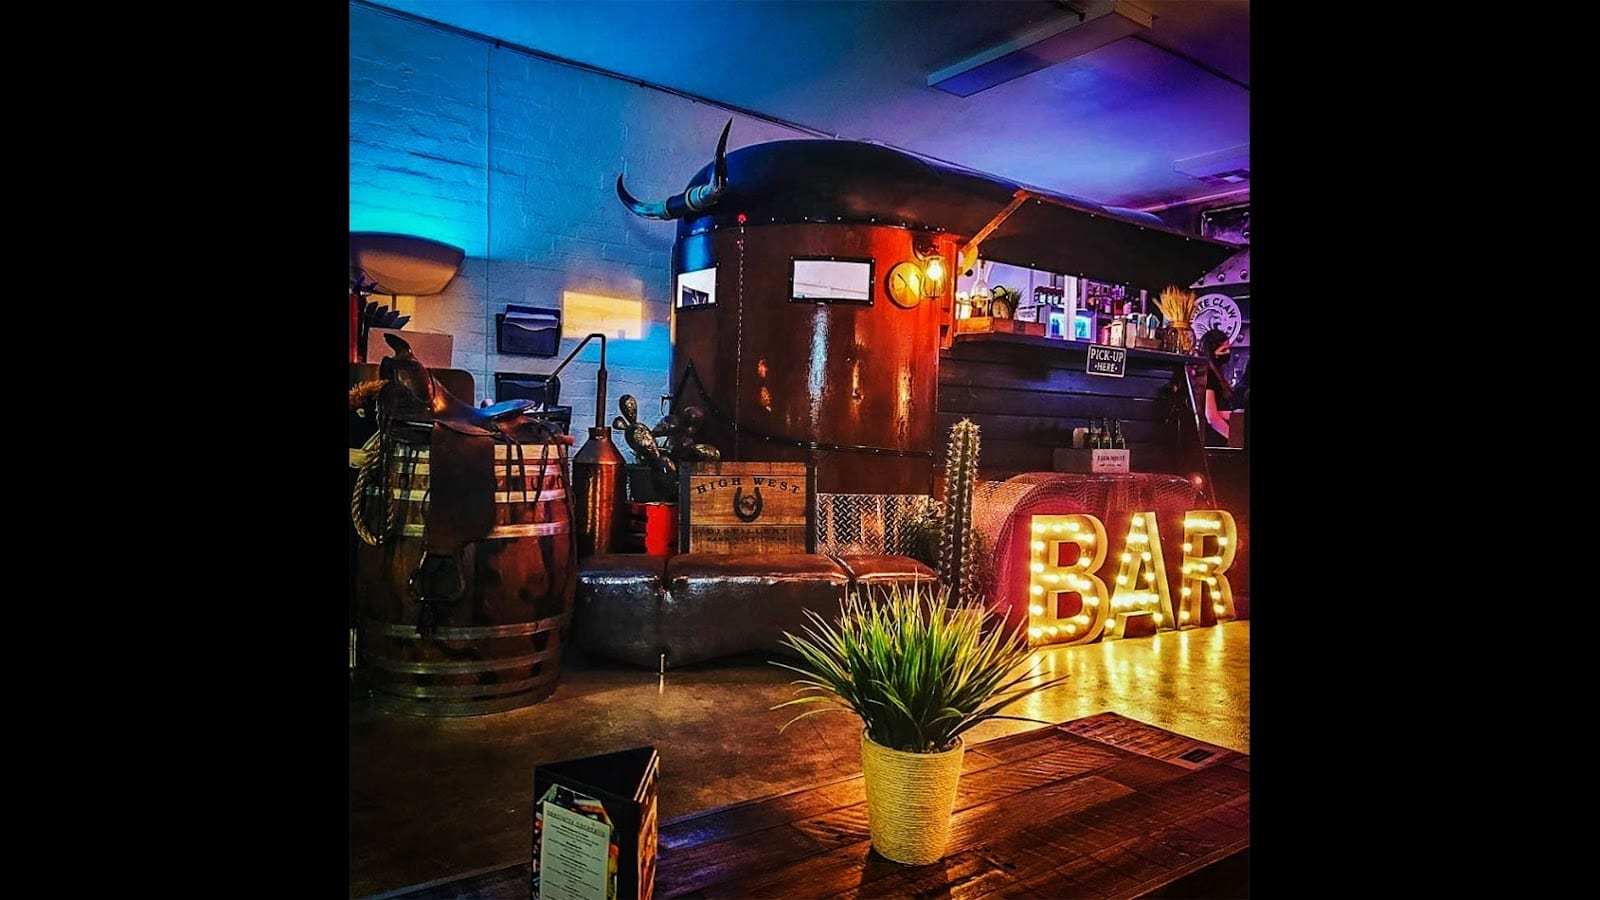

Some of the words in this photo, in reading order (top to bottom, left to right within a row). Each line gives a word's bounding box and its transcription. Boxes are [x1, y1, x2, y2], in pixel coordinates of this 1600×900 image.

[1212, 297, 1237, 318] CLAW
[1090, 348, 1124, 363] PICK-UP
[1096, 361, 1116, 373] HERE
[695, 477, 742, 495] HIGH
[752, 477, 801, 495] WEST
[1027, 509, 1238, 649] BAR
